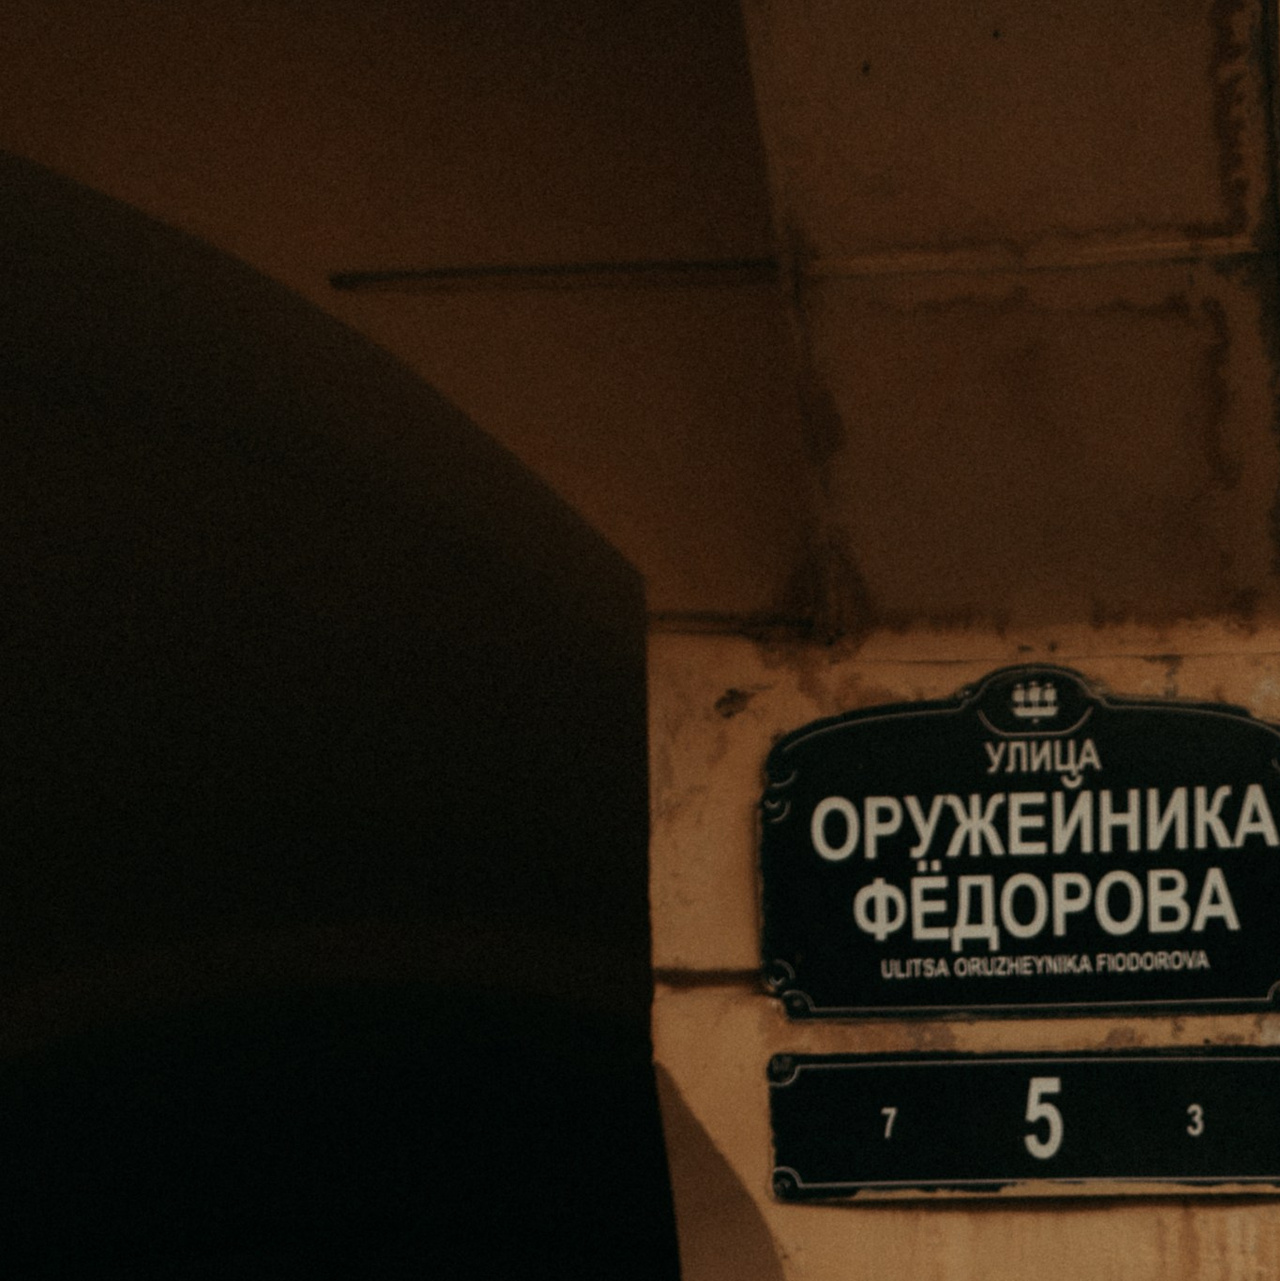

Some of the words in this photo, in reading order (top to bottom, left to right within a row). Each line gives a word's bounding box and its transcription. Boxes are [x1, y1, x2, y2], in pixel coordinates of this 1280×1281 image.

[985, 738, 1101, 775] УЛИЦА
[810, 774, 1280, 861] ОРУЖЕЙНИКА
[852, 859, 1241, 952] ФЁДОРОВА
[881, 957, 950, 979] ULITSA
[953, 953, 1093, 977] ORUZHEYNIKA
[1095, 949, 1211, 973] FIODOROVA
[880, 1106, 897, 1138] 7
[1023, 1076, 1064, 1159] 5
[1186, 1103, 1205, 1136] 3
